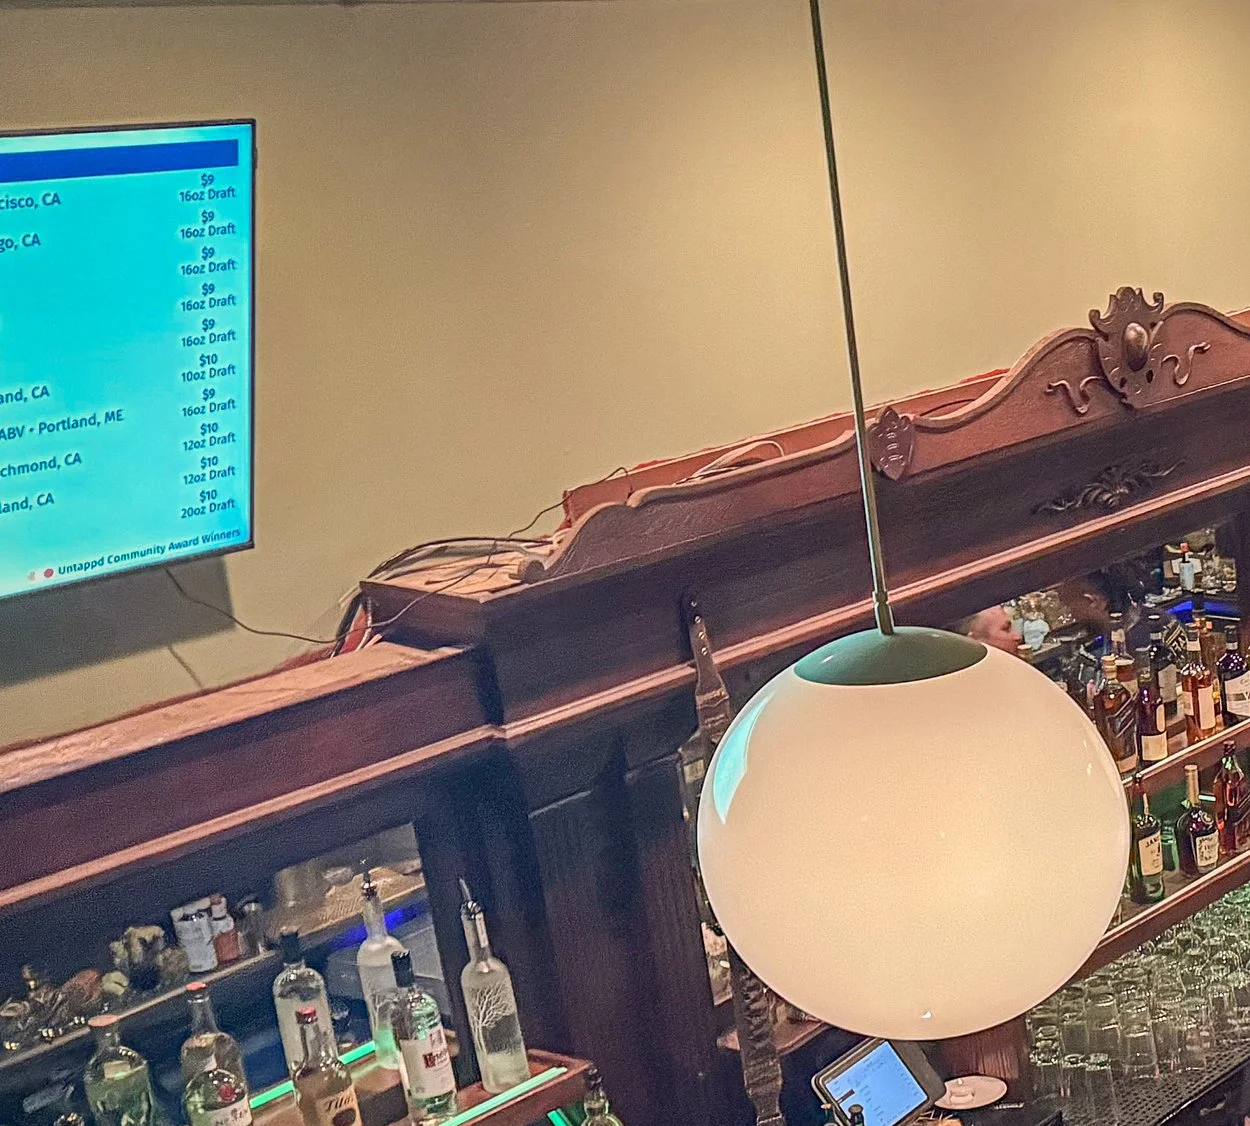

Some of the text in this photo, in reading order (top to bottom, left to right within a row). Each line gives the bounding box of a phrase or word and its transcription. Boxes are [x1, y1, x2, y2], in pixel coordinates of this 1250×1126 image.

[201, 173, 214, 187] $9
[42, 193, 61, 206] CA
[180, 186, 236, 202] 16oz Draft
[202, 210, 214, 224] $9
[181, 223, 236, 239] 16oz Draft
[22, 234, 41, 247] CA
[202, 246, 215, 260] $9
[181, 259, 235, 275] 16oz Draft
[202, 283, 215, 296] $9
[181, 294, 235, 311] 16oz Draft
[202, 319, 215, 332] $9
[182, 329, 236, 346] 16oz Draft
[199, 354, 217, 367] $10
[182, 364, 235, 382] 10oz Draft
[32, 386, 49, 398] CA
[203, 388, 215, 401] $9
[182, 398, 235, 416] 16oz Draft
[39, 413, 100, 434] Portland,
[105, 409, 123, 423] ME
[201, 423, 218, 437] $10
[183, 432, 235, 451] 12oz Draft
[64, 453, 81, 465] CA
[201, 456, 218, 469] $10
[184, 465, 235, 484] 12oz Draft
[37, 493, 54, 506] CA
[200, 490, 217, 504] $10
[181, 498, 235, 518] 20oz Draft
[59, 529, 241, 575] Untappd Community Award Winners
